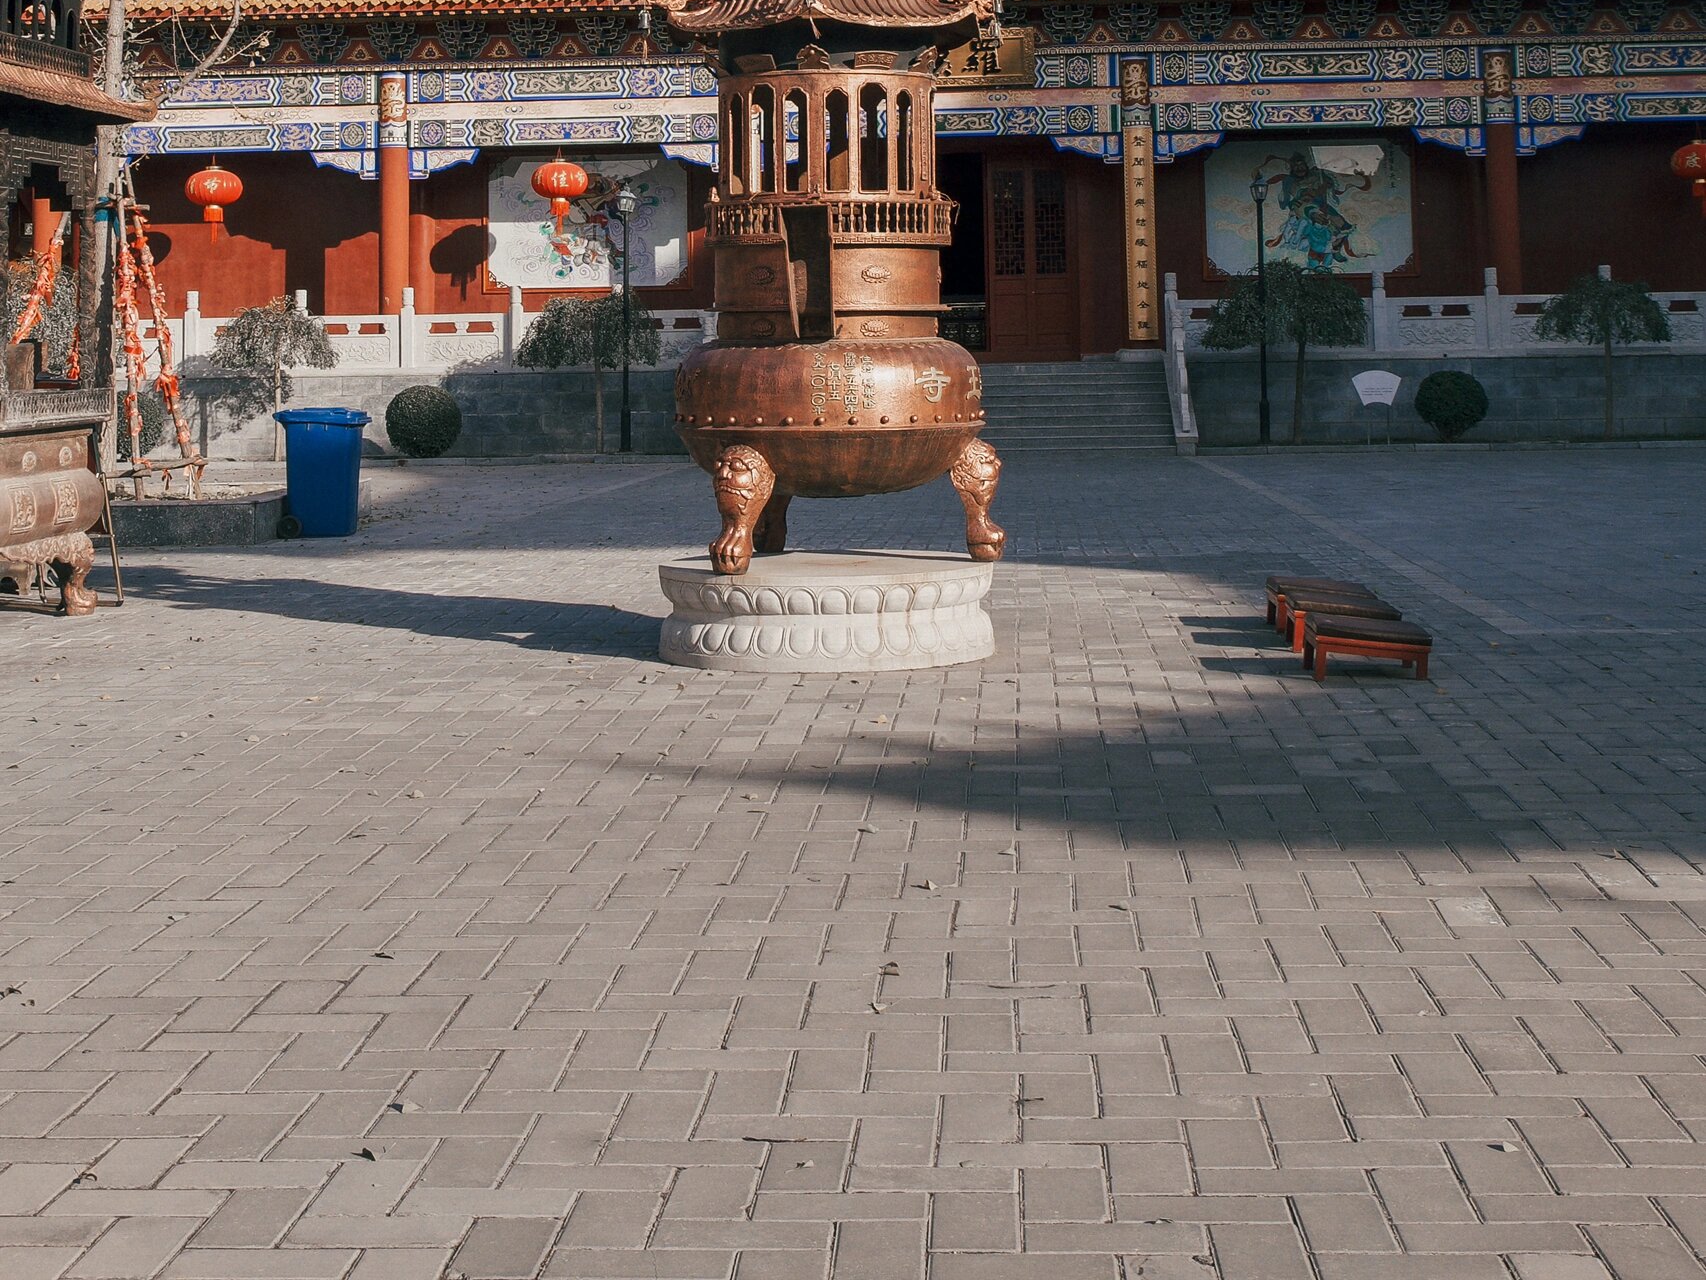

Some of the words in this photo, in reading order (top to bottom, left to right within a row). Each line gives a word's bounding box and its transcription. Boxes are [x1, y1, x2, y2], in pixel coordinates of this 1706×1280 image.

[827, 361, 842, 401] 七月十五
[916, 366, 952, 403] 寺
